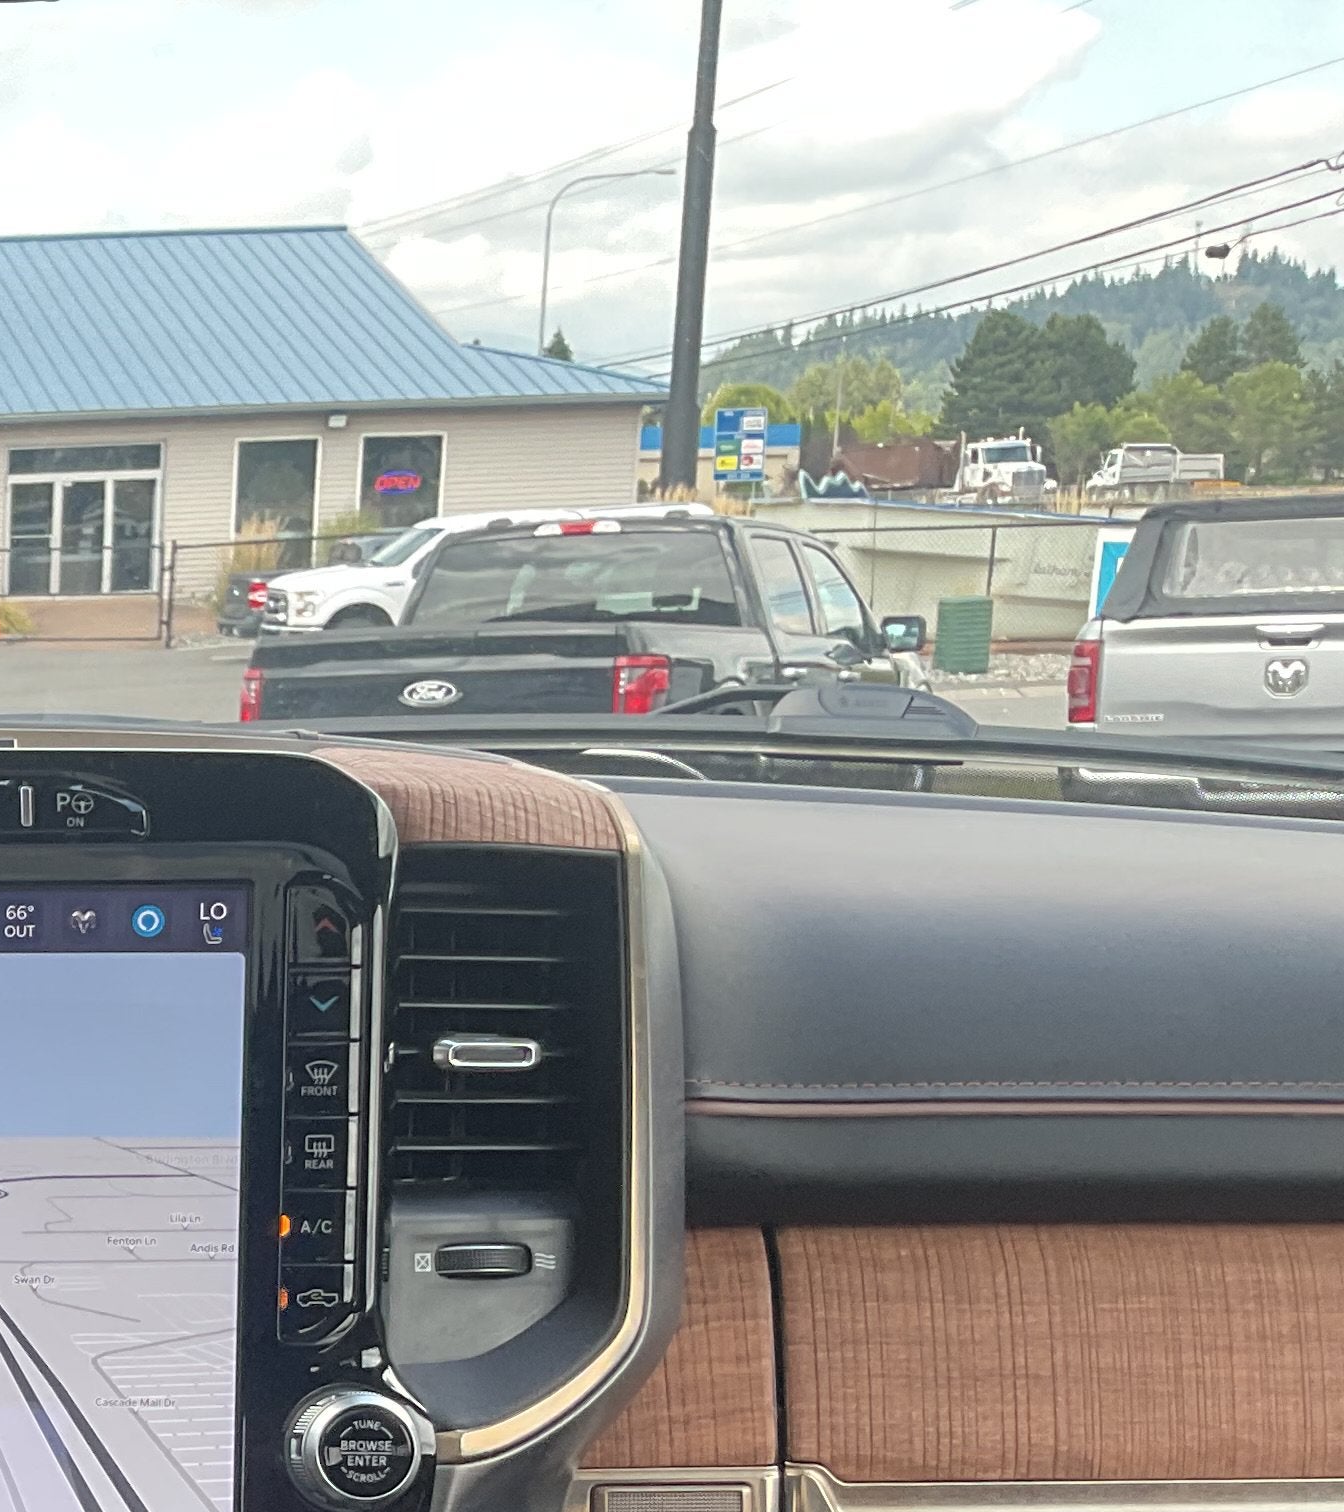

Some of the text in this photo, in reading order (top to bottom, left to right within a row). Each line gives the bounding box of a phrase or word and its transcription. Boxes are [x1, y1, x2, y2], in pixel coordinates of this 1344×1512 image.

[374, 475, 422, 491] OPEN
[66, 816, 85, 828] ON
[5, 904, 35, 921] 66°
[199, 902, 227, 921] LO
[4, 925, 36, 938] OUT
[301, 1085, 338, 1097] FRONT
[304, 1159, 334, 1169] REAR
[190, 1214, 201, 1223] Ln
[300, 1219, 333, 1233] A/C
[107, 1236, 156, 1246] Fenton Ln
[190, 1243, 235, 1253] Andis Rd
[14, 1275, 55, 1284] Swan Dr
[95, 1398, 138, 1407] Cascade
[164, 1398, 176, 1408] Dr
[352, 1419, 382, 1431] TUNE
[340, 1440, 393, 1451] BROWSE
[347, 1455, 387, 1467] ENTER
[345, 1469, 387, 1483] SCROLL
